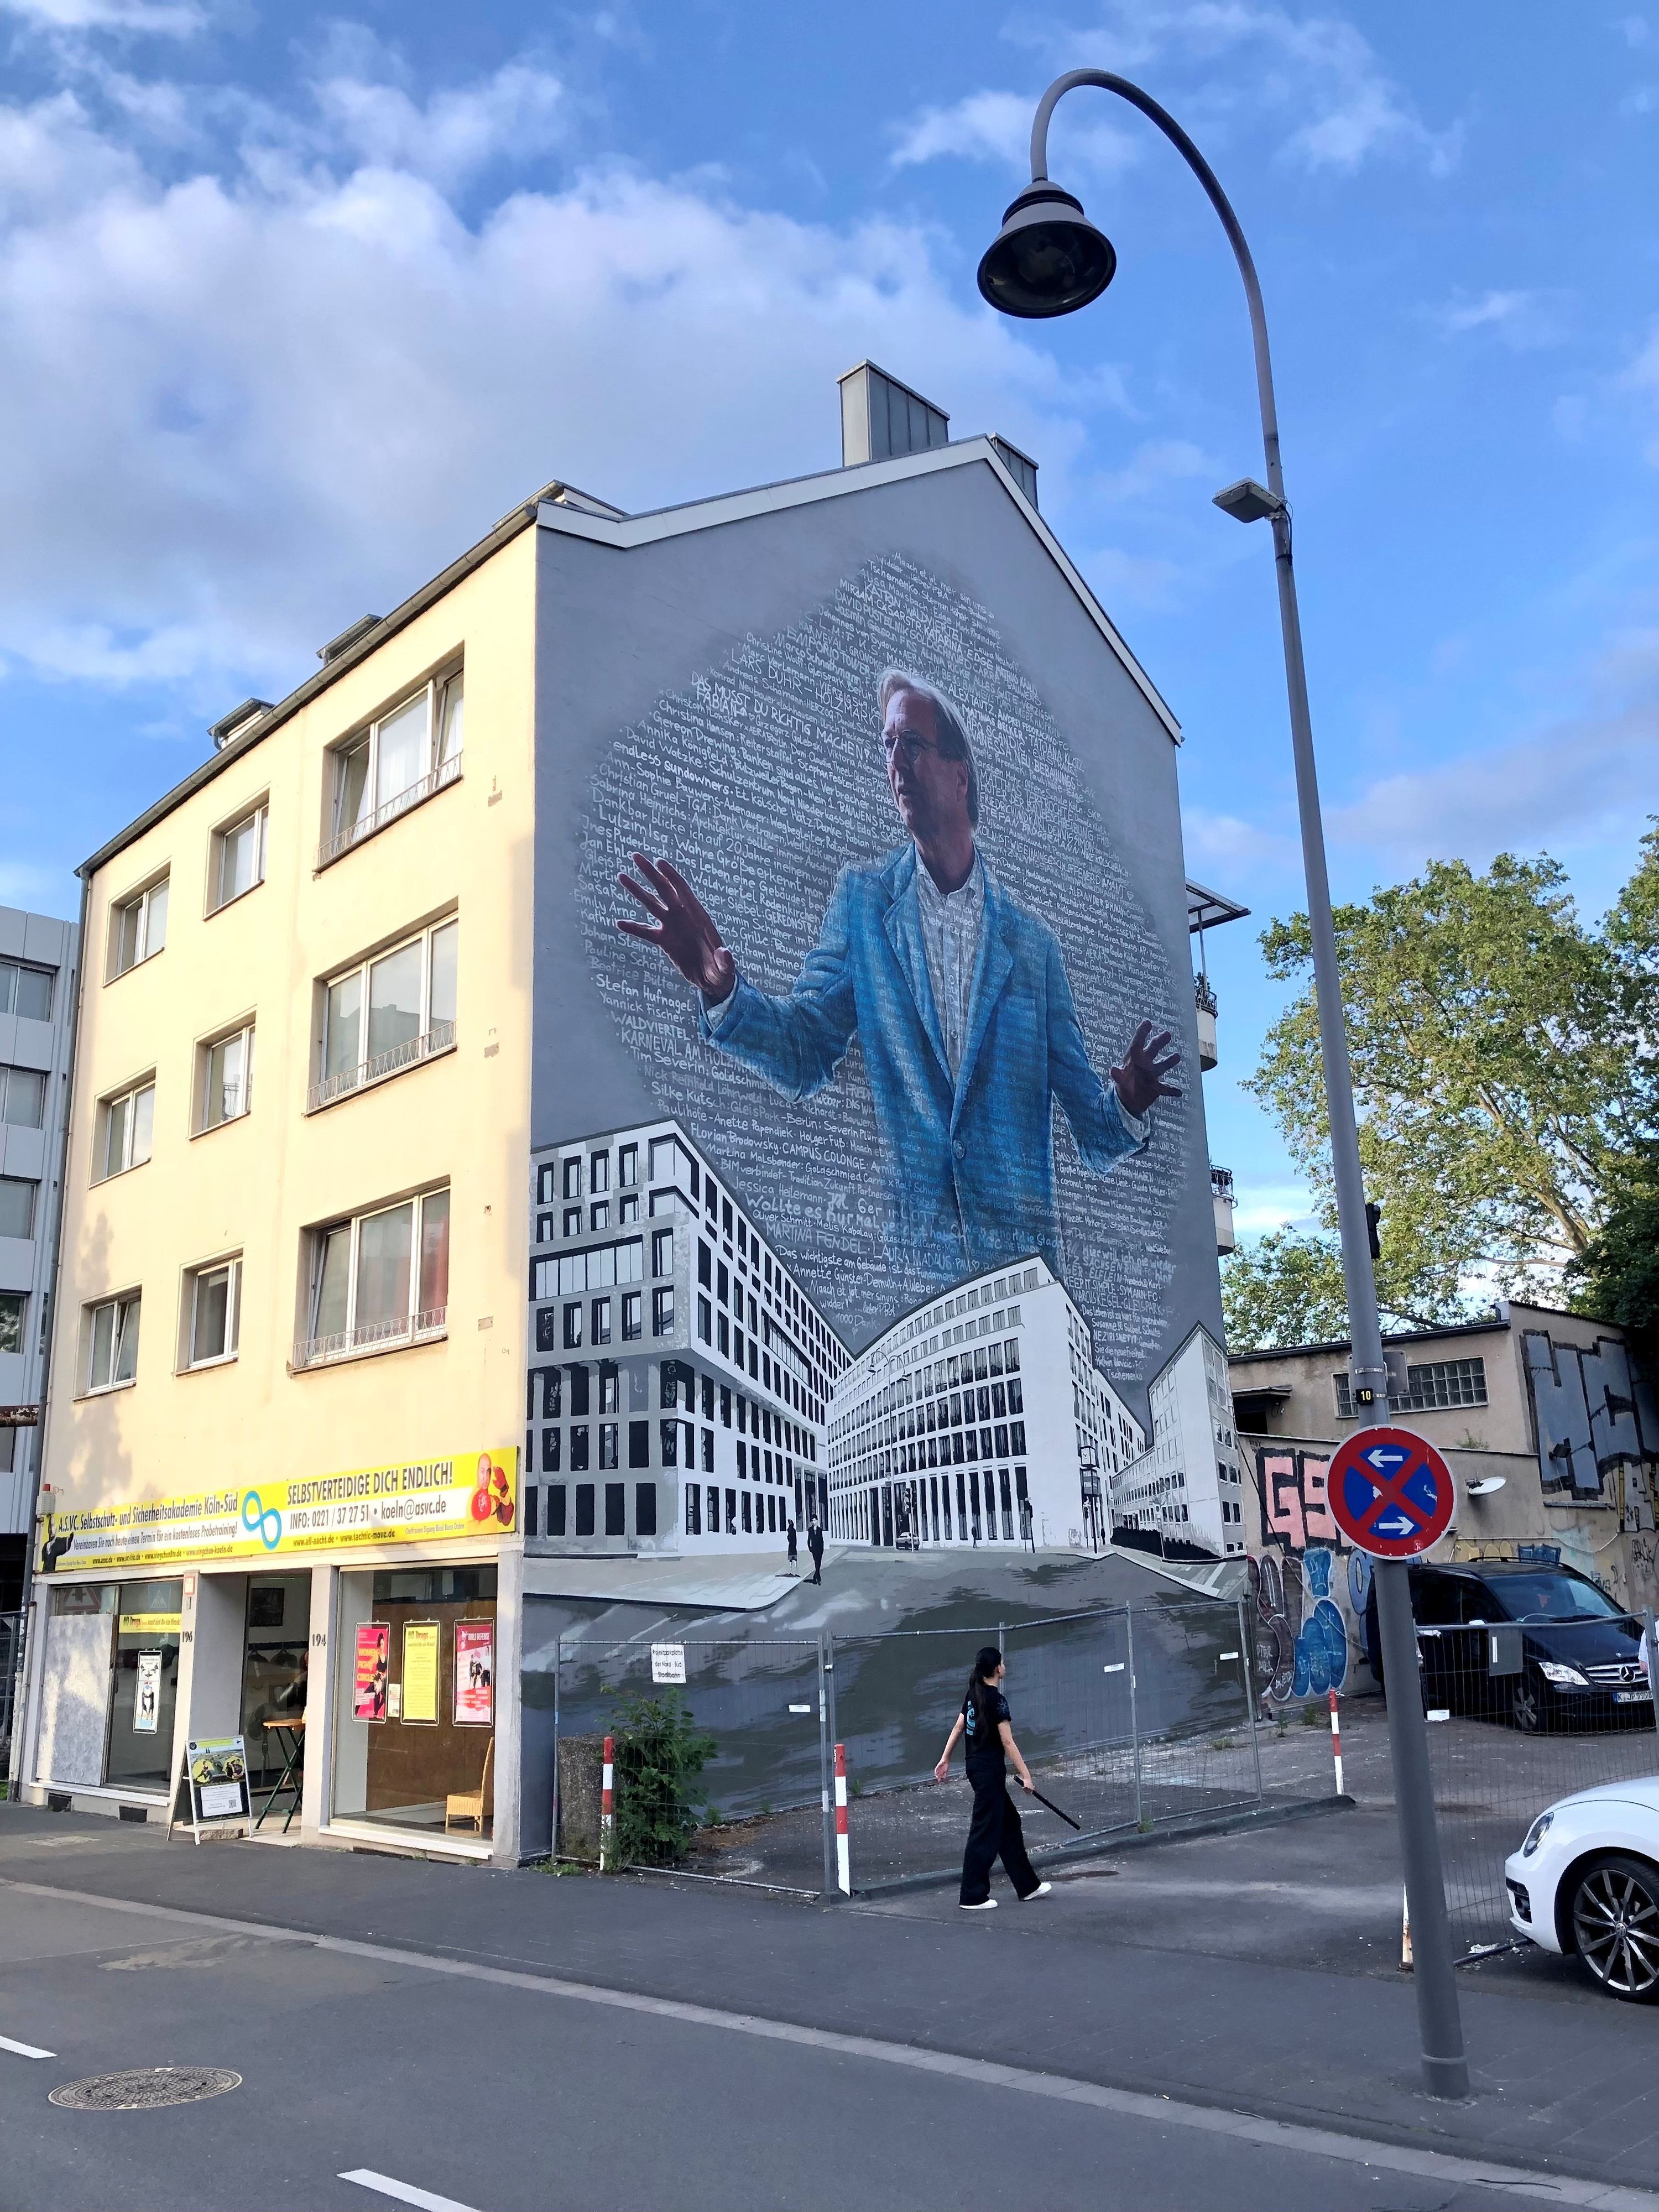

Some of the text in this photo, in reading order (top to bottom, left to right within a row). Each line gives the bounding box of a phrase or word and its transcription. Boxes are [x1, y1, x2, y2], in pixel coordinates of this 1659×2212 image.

[692, 671, 711, 691] DAS
[714, 682, 750, 708] MUSST
[754, 699, 768, 716] DU
[659, 700, 704, 727] Christina
[625, 726, 655, 749] David
[599, 763, 649, 792] Christian
[604, 751, 672, 786] Ann-Sophie
[590, 774, 635, 800] Sabrina
[735, 786, 749, 801] Et
[651, 809, 770, 866] blicke ich auf 20 Jahre
[674, 833, 714, 859] Wahre
[757, 868, 801, 891] erkennt
[676, 849, 696, 868] Das
[700, 858, 730, 883] Leben
[733, 874, 755, 888] eine
[759, 880, 806, 907] Gebäudes
[690, 869, 757, 904] Waldviertel
[585, 939, 676, 975] Pauline Schäfer
[596, 974, 639, 997] Stefan
[599, 991, 685, 1023] Yannick Fischer
[621, 1027, 701, 1061] KARNEVAL AM
[630, 1046, 709, 1076] Tim Severin:
[651, 1082, 684, 1101] Silke
[800, 1131, 828, 1146] Holger
[782, 1142, 822, 1161] CAMPUS
[823, 1150, 866, 1170] COLONGE
[733, 1176, 774, 1193] Jessica
[745, 1193, 822, 1219] Wollte es
[766, 1222, 812, 1243] MARTINA
[816, 1230, 867, 1254] FENDEL
[775, 1244, 797, 1259] Das
[844, 1259, 855, 1269] am
[889, 1265, 902, 1274] ist
[836, 1312, 853, 1324] 1000
[1361, 1390, 1371, 1400] 10
[288, 1462, 452, 1505] SELBSTVERTEIDIGE DICH ENDLICH!
[81, 1510, 117, 1530] Selbstschutz-
[119, 1506, 131, 1525] und
[133, 1498, 202, 1524] Sicherheitsakademie
[205, 1491, 238, 1515] Köln-Süd
[290, 1495, 446, 1529] INFO: 0221 / 37 27 51 koeln@asvc.de
[74, 1538, 97, 1550] Vereinbaren
[105, 1535, 114, 1547] noch
[116, 1534, 127, 1546] heute
[128, 1533, 139, 1545] einen
[140, 1531, 155, 1544] Termin
[173, 1526, 200, 1540] kostenloses
[201, 1521, 237, 1538] Probetraining!
[182, 1631, 192, 1642] 196
[311, 1634, 326, 1647] 194
[358, 1648, 378, 1657] WOMEN
